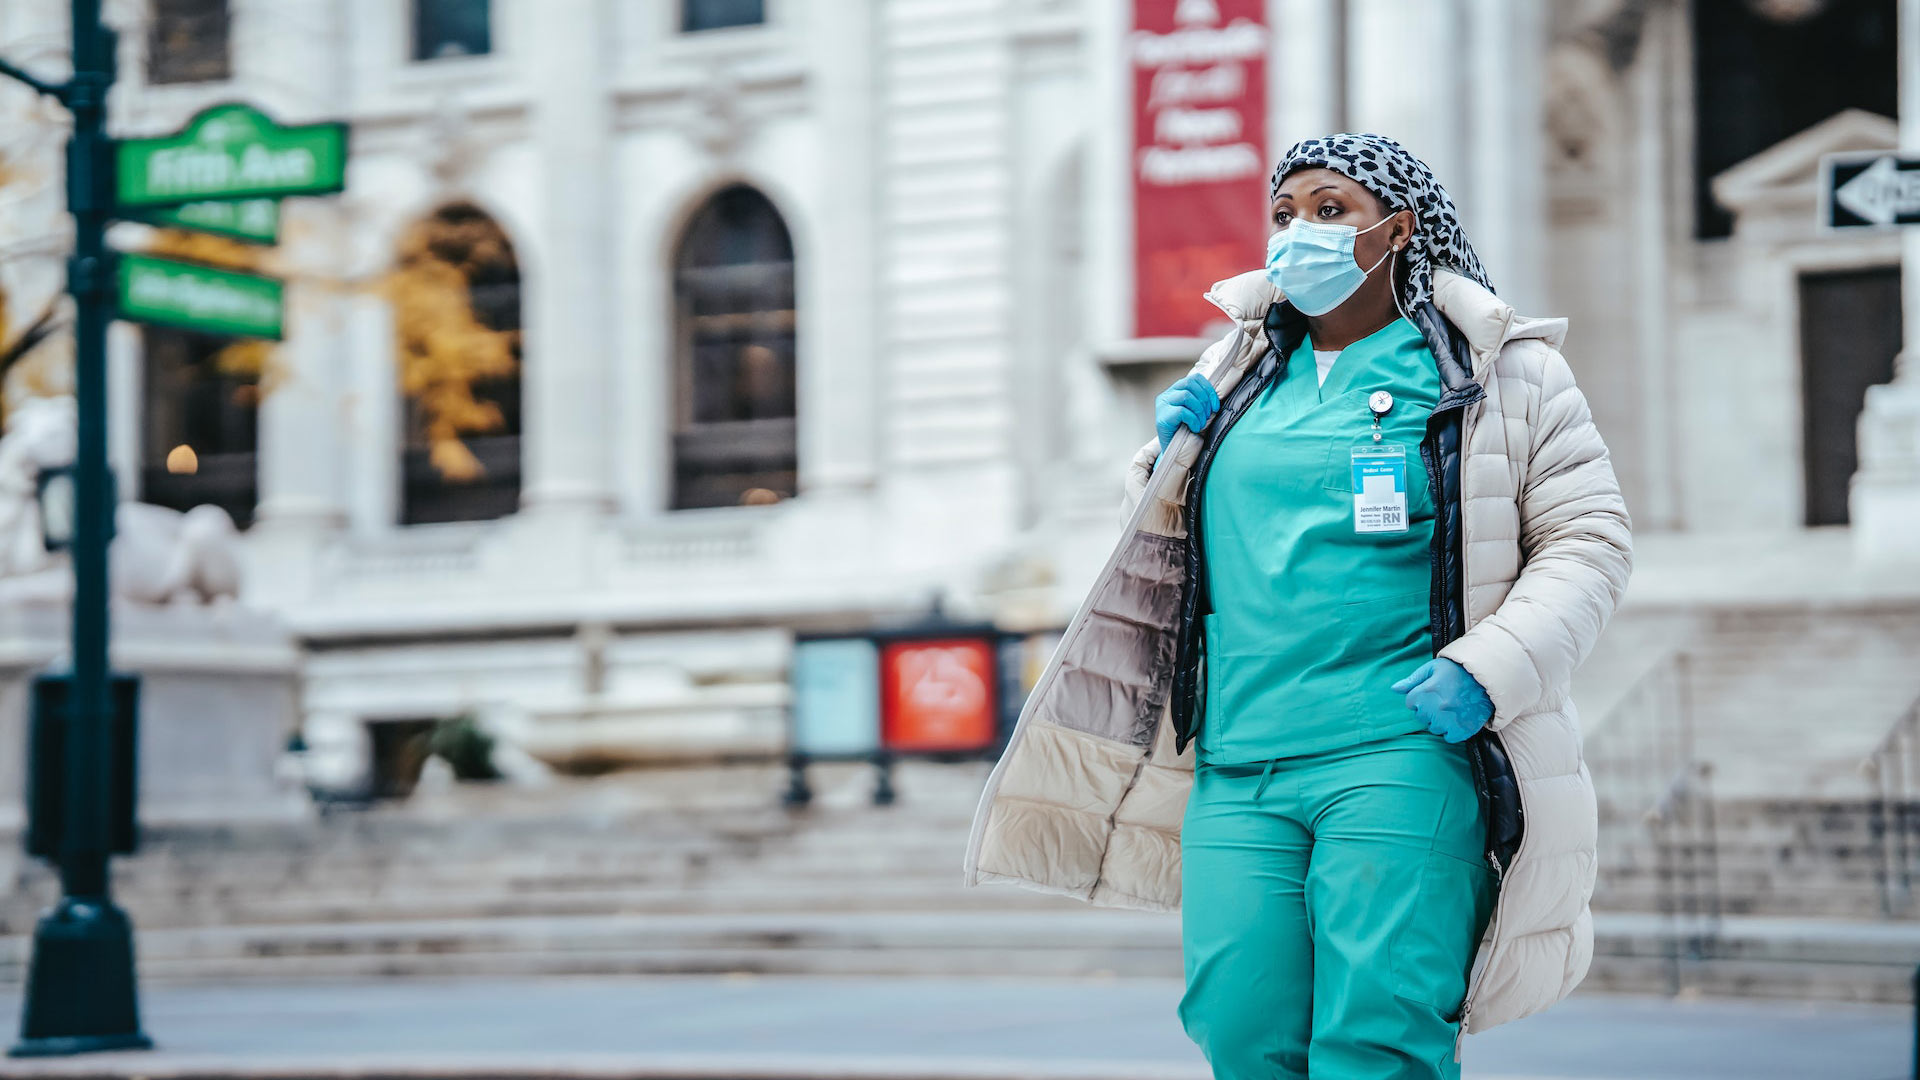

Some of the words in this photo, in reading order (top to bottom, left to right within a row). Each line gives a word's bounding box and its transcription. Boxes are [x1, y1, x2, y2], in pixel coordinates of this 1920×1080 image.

[147, 147, 234, 194] Fifth
[241, 142, 315, 187] Ave
[1383, 512, 1400, 523] RN
